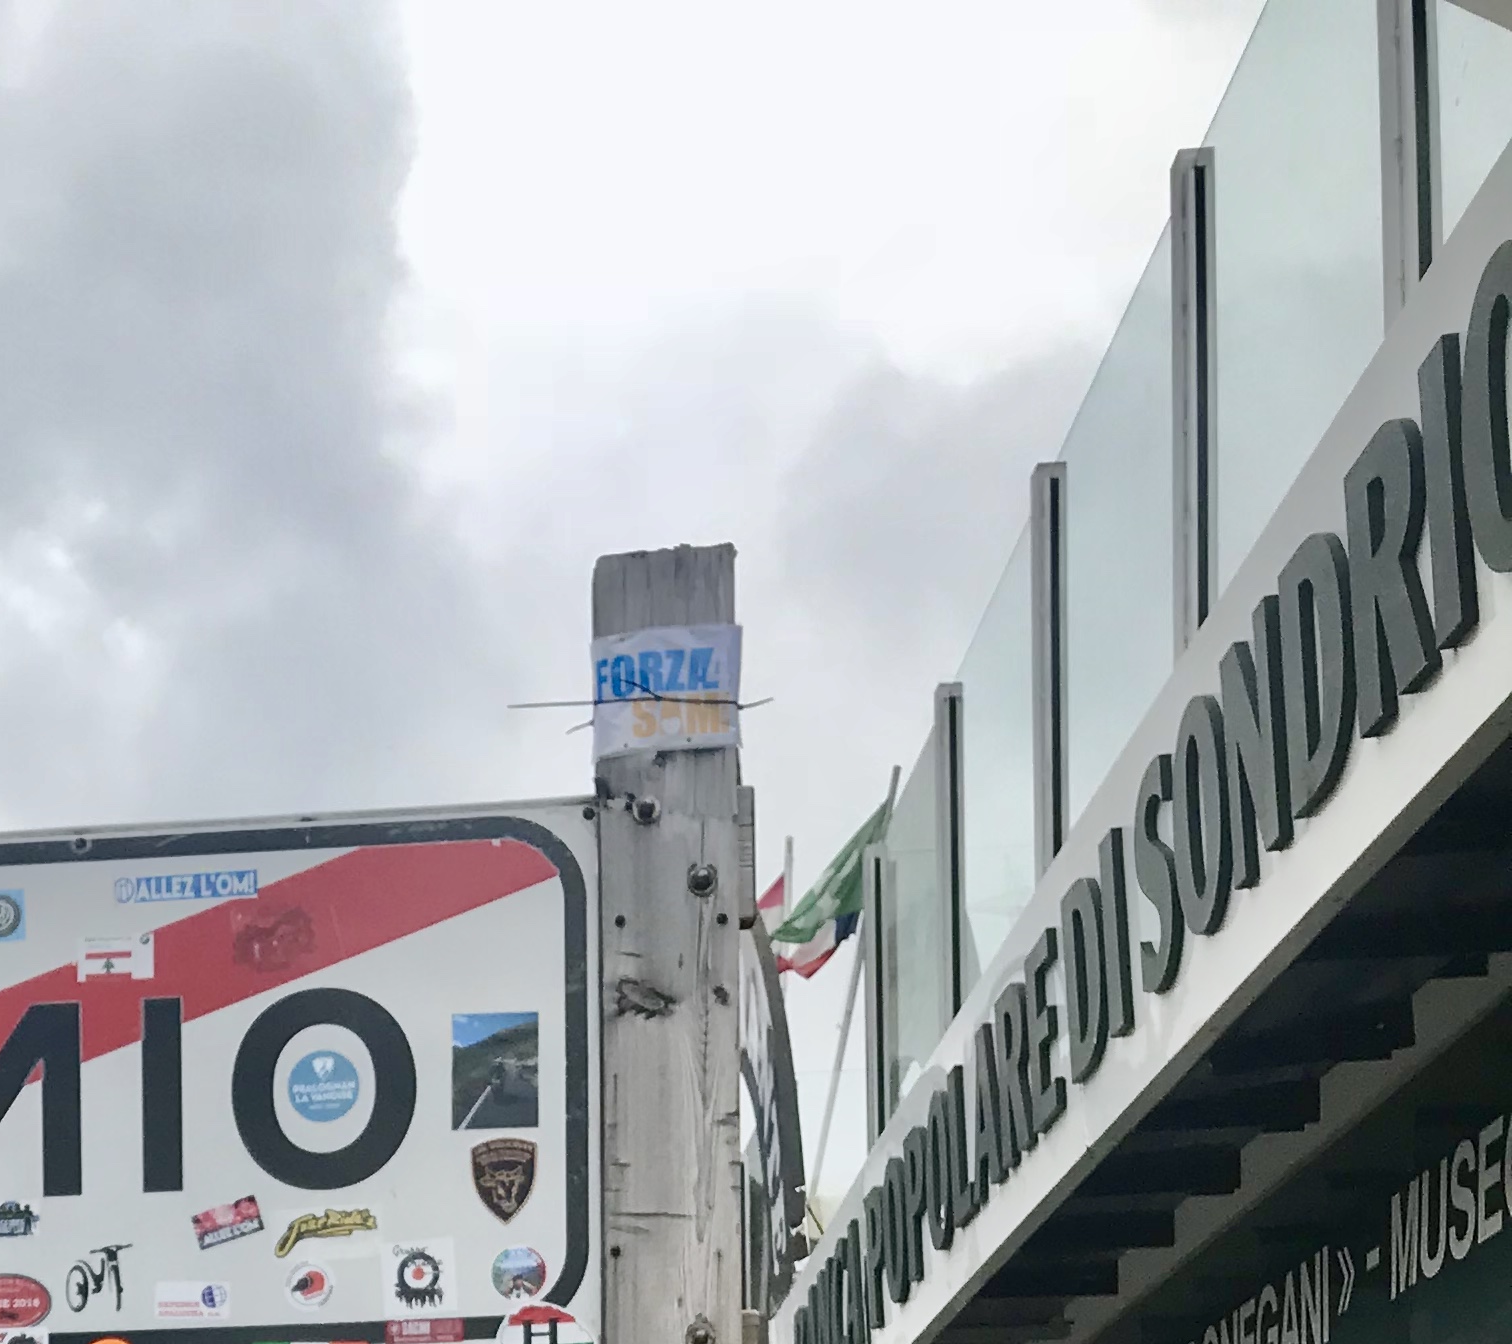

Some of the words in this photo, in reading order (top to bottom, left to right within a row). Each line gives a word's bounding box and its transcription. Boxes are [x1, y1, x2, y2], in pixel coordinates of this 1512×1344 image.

[137, 874, 195, 901] ALLEZ
[199, 871, 256, 898] L'OM!
[864, 926, 1066, 1329] POPOLARE
[1060, 826, 1137, 1085] DI
[1389, 1113, 1512, 1301] MUSE
